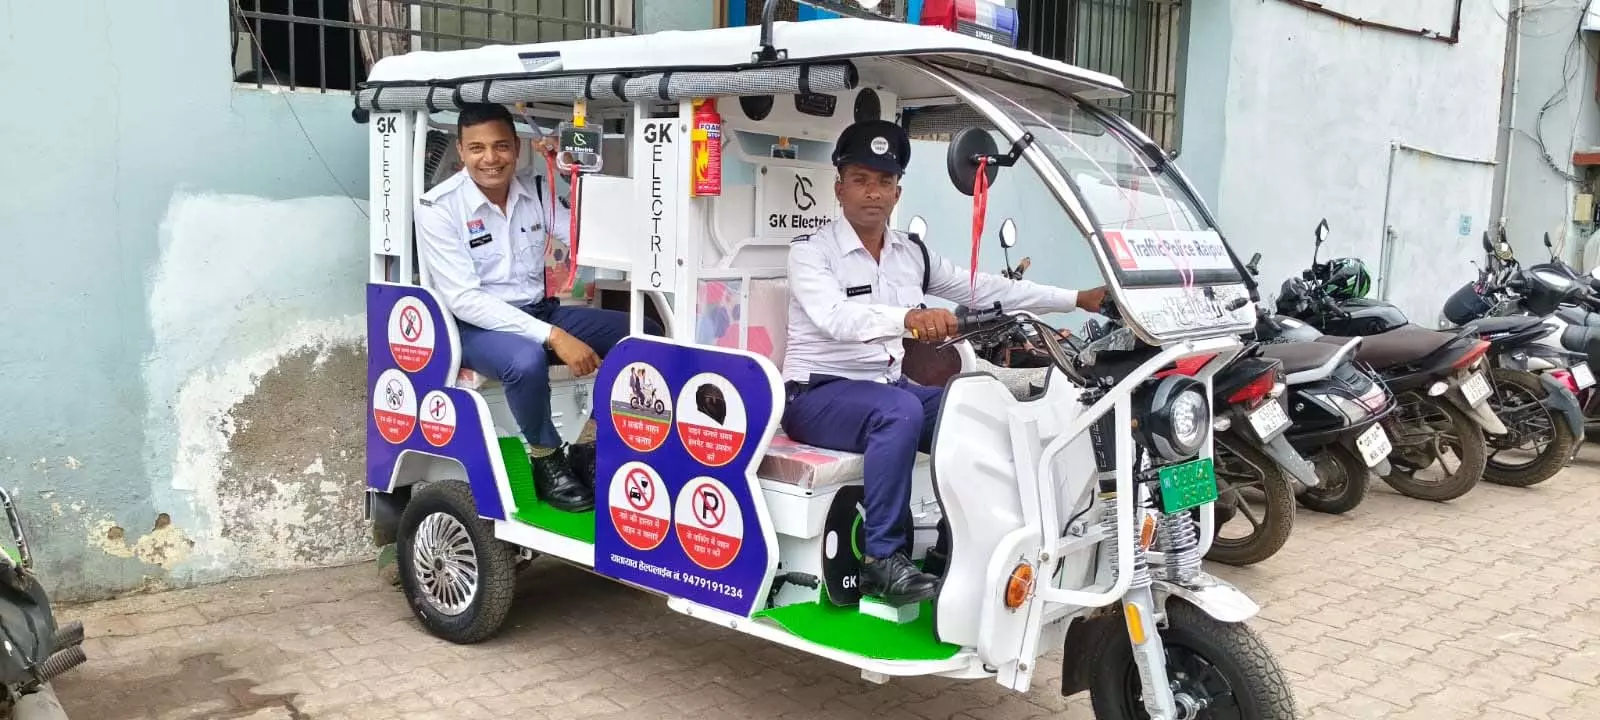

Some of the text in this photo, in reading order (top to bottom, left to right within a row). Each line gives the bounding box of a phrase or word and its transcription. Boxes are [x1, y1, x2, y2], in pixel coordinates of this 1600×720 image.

[377, 116, 397, 133] GK
[643, 123, 672, 144] GK
[383, 134, 391, 252] ELECTRIC
[651, 144, 663, 288] ELECTRIC
[769, 213, 787, 228] GK
[1127, 237, 1226, 262] Traffic Police Raipur
[683, 574, 743, 599] 9479191234
[842, 575, 857, 589] GK
